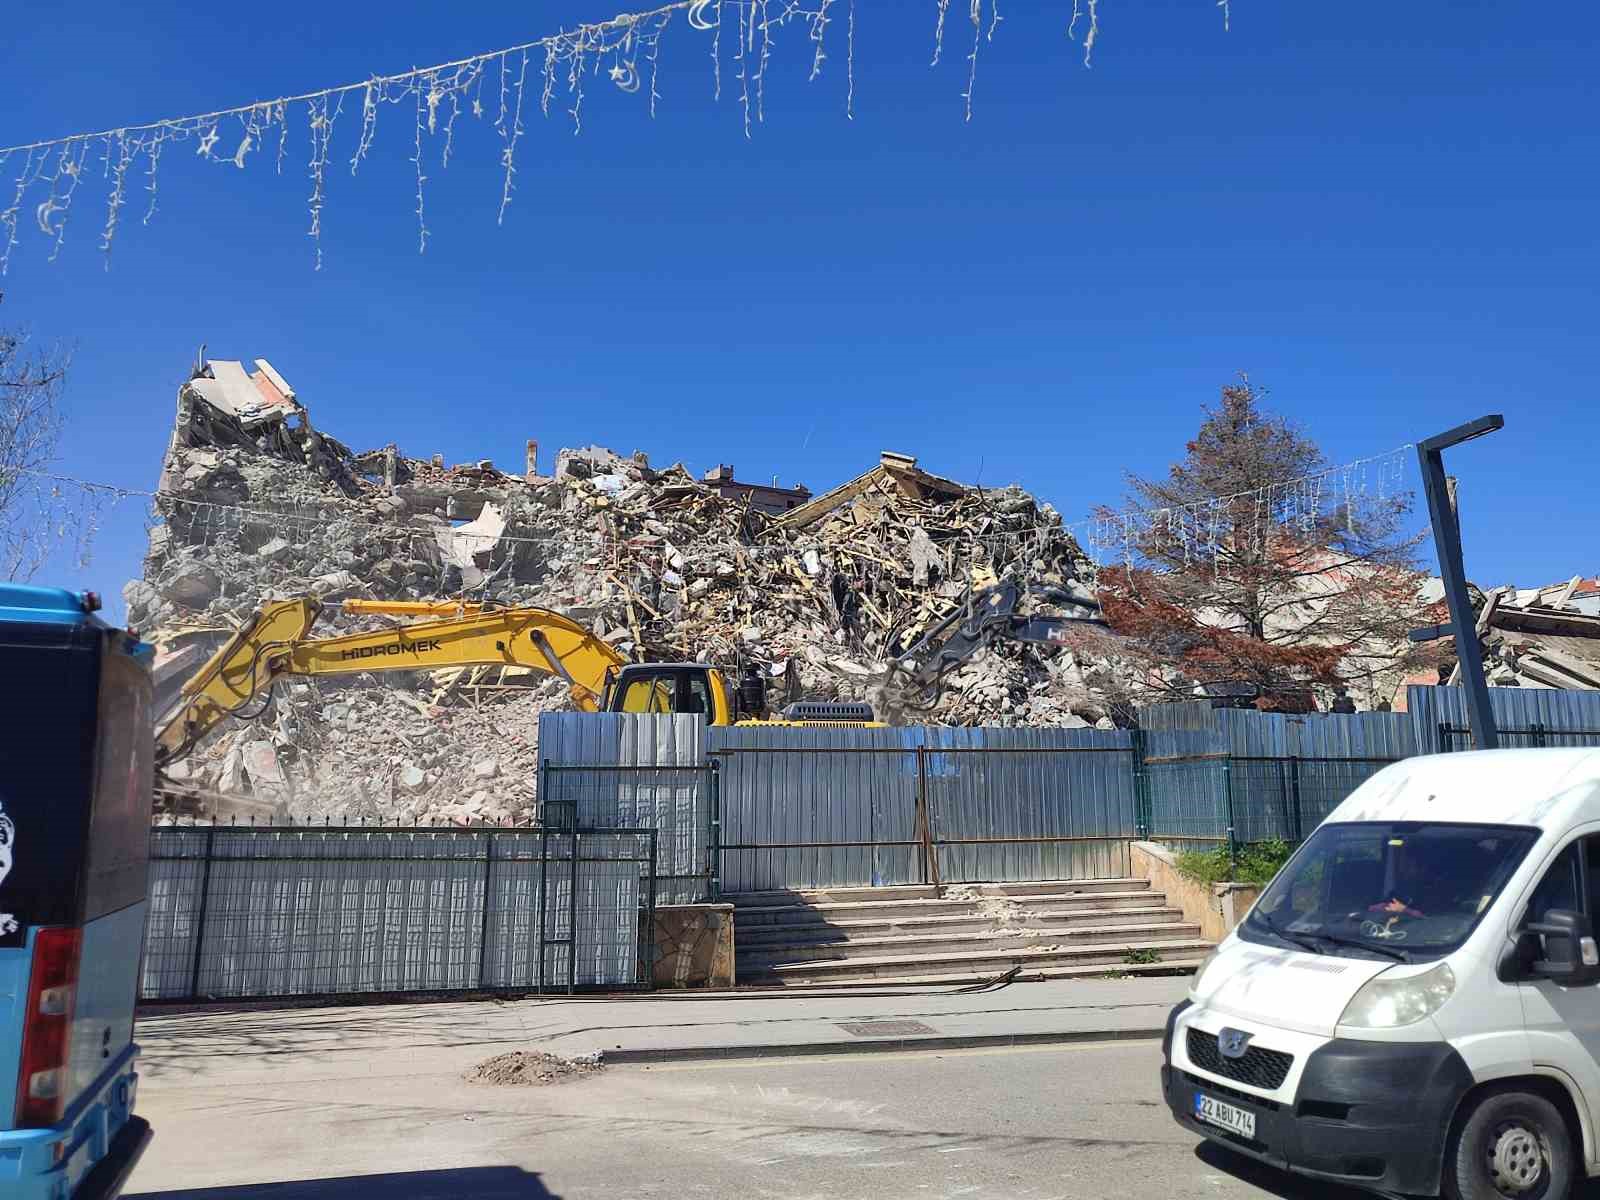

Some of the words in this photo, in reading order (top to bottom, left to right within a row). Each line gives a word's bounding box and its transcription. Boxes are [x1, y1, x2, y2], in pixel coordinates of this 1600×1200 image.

[1201, 1097, 1213, 1115] 22
[1216, 1103, 1234, 1124] ABU
[1236, 1110, 1252, 1131] 714
